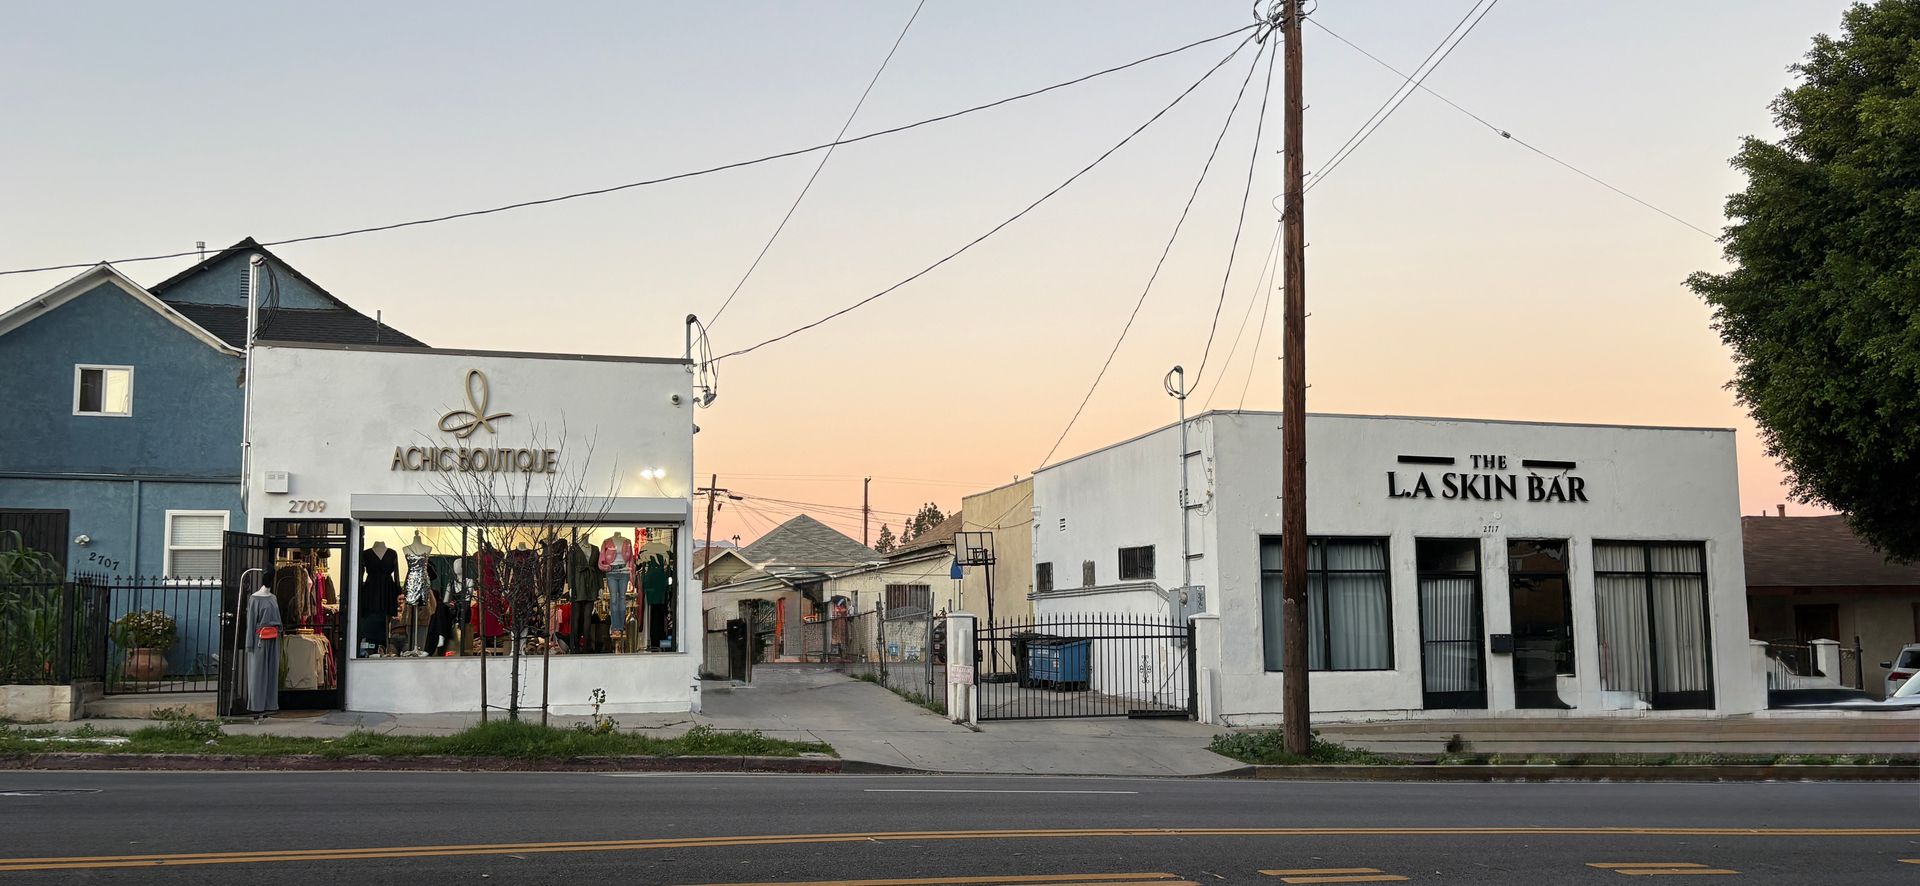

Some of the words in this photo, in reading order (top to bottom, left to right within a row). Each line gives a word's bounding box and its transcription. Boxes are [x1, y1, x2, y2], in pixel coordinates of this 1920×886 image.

[391, 446, 453, 472] ACHIC
[458, 447, 557, 474] BOUTIQUE
[1470, 454, 1508, 470] THE
[1387, 471, 1434, 499] L.A
[1442, 472, 1518, 501] SKIN
[1526, 475, 1590, 503] BAR
[288, 499, 328, 514] 2709
[89, 551, 120, 571] 2707
